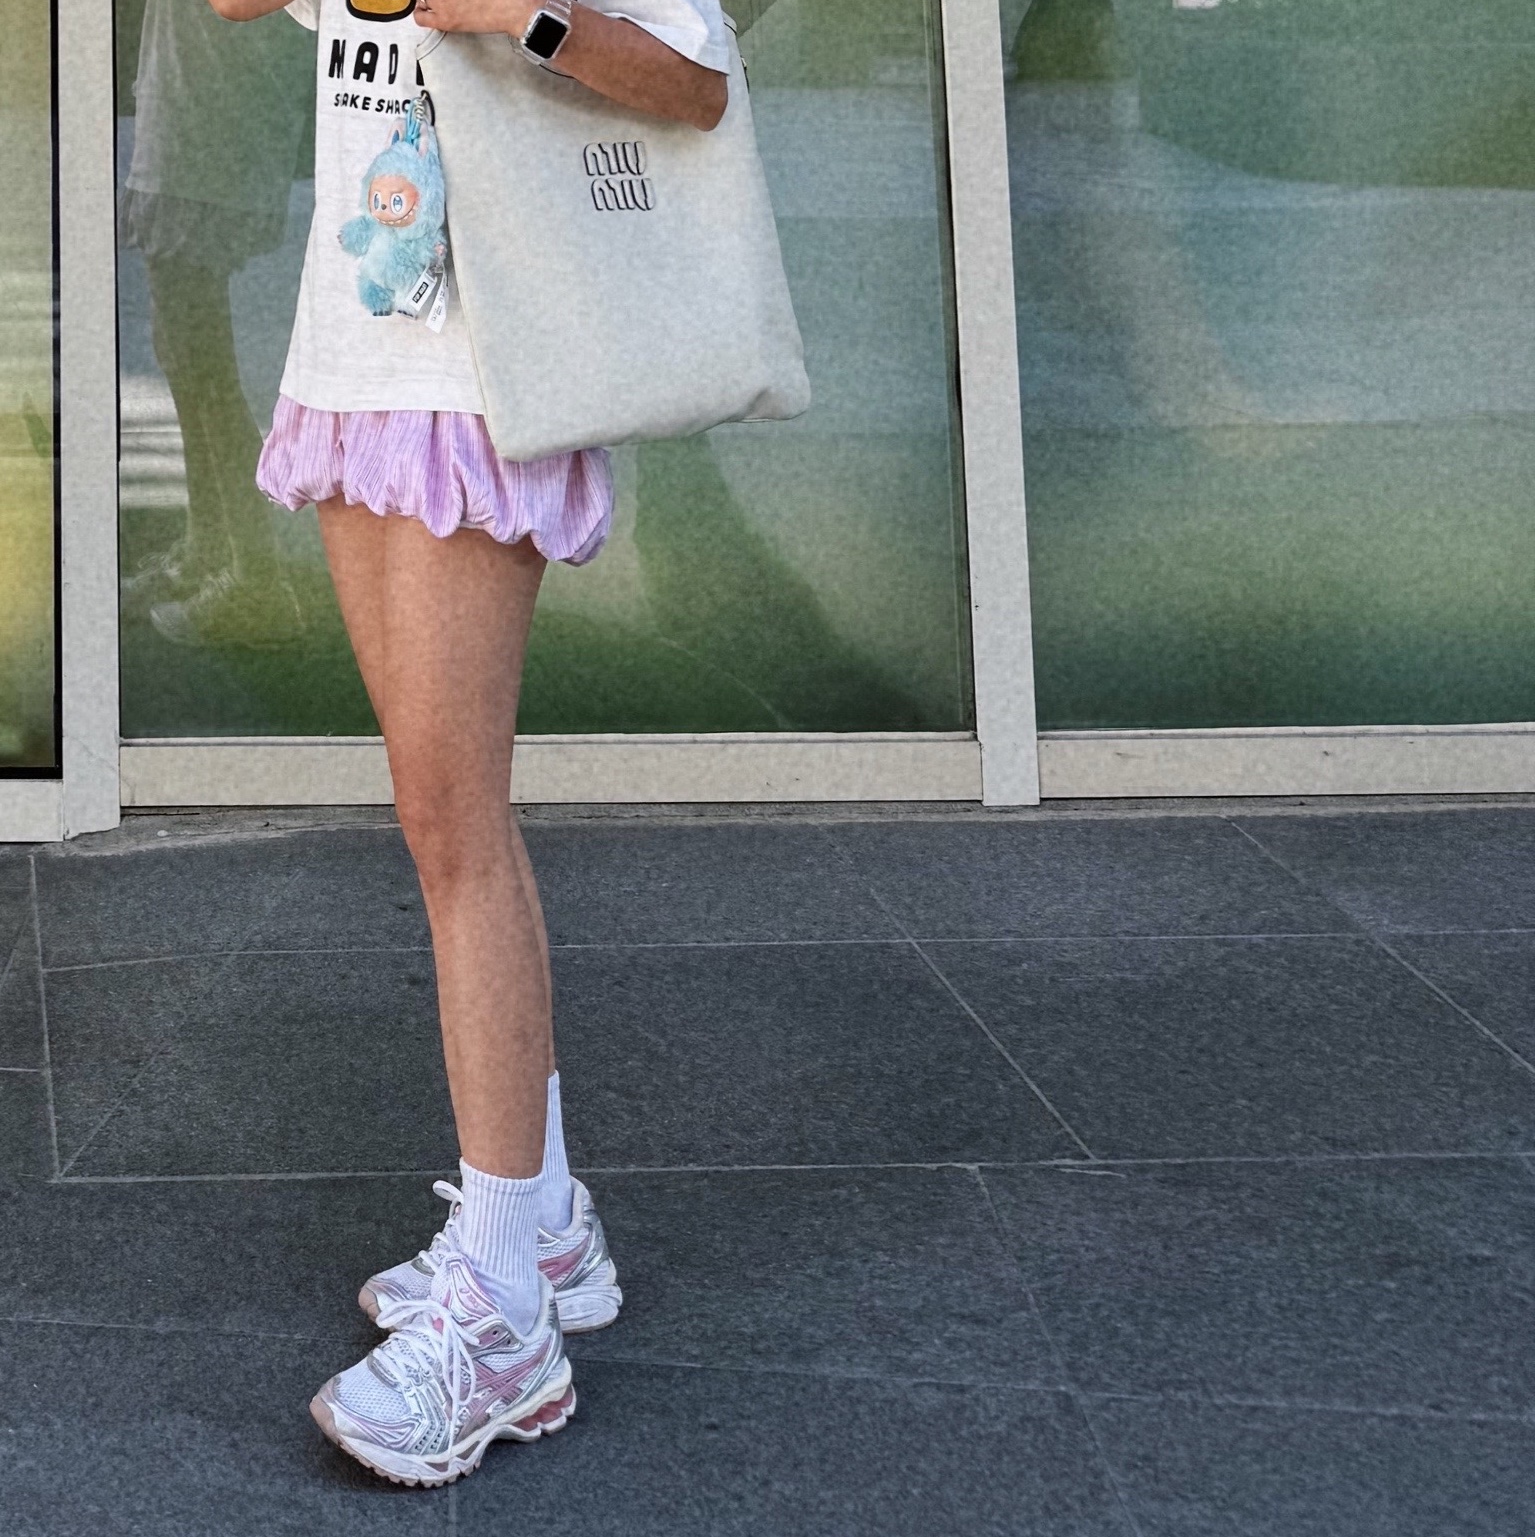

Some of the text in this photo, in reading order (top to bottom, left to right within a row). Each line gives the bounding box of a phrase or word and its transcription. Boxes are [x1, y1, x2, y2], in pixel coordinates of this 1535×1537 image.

[328, 38, 425, 86] NAD
[333, 92, 411, 115] SAKE SHAC
